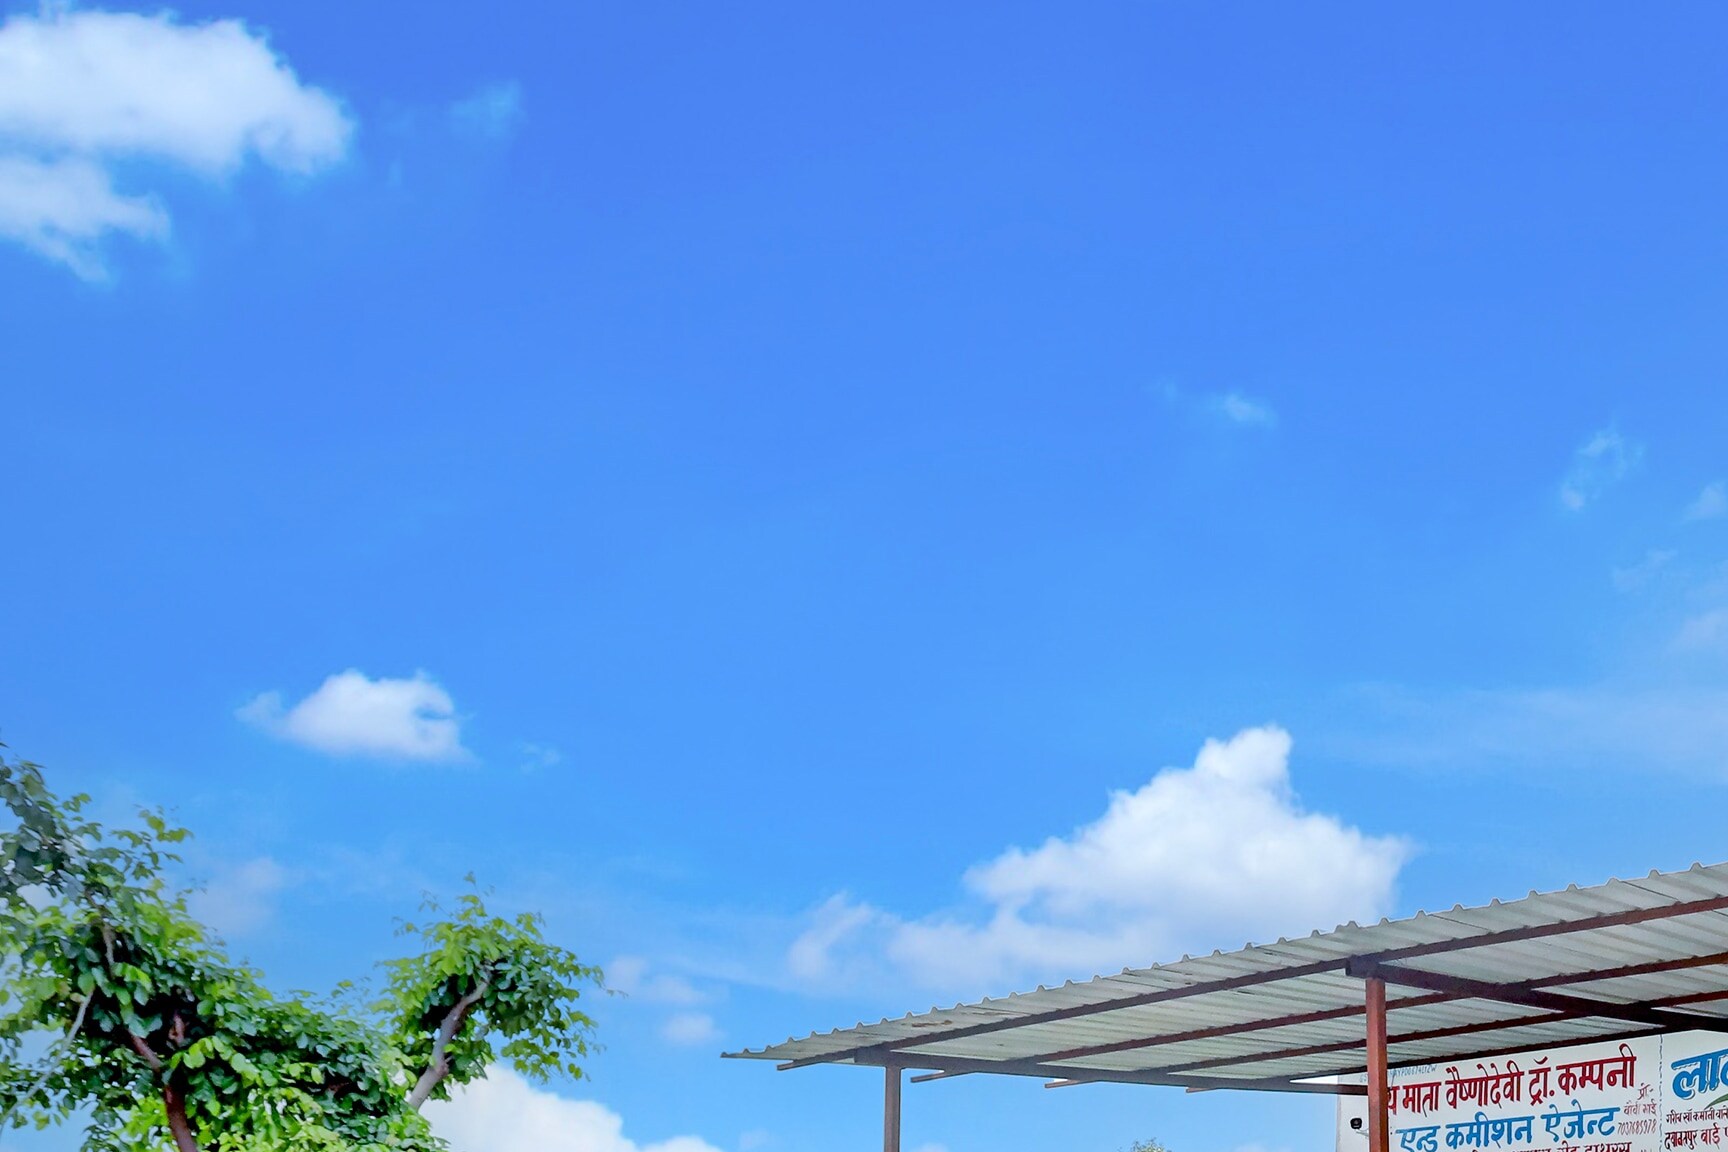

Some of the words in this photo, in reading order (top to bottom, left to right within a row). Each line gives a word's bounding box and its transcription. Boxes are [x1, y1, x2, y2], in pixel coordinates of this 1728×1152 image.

[1403, 1082, 1441, 1117] माता
[1556, 1043, 1637, 1096] कम्पनी
[1446, 1111, 1536, 1150] कमीशन
